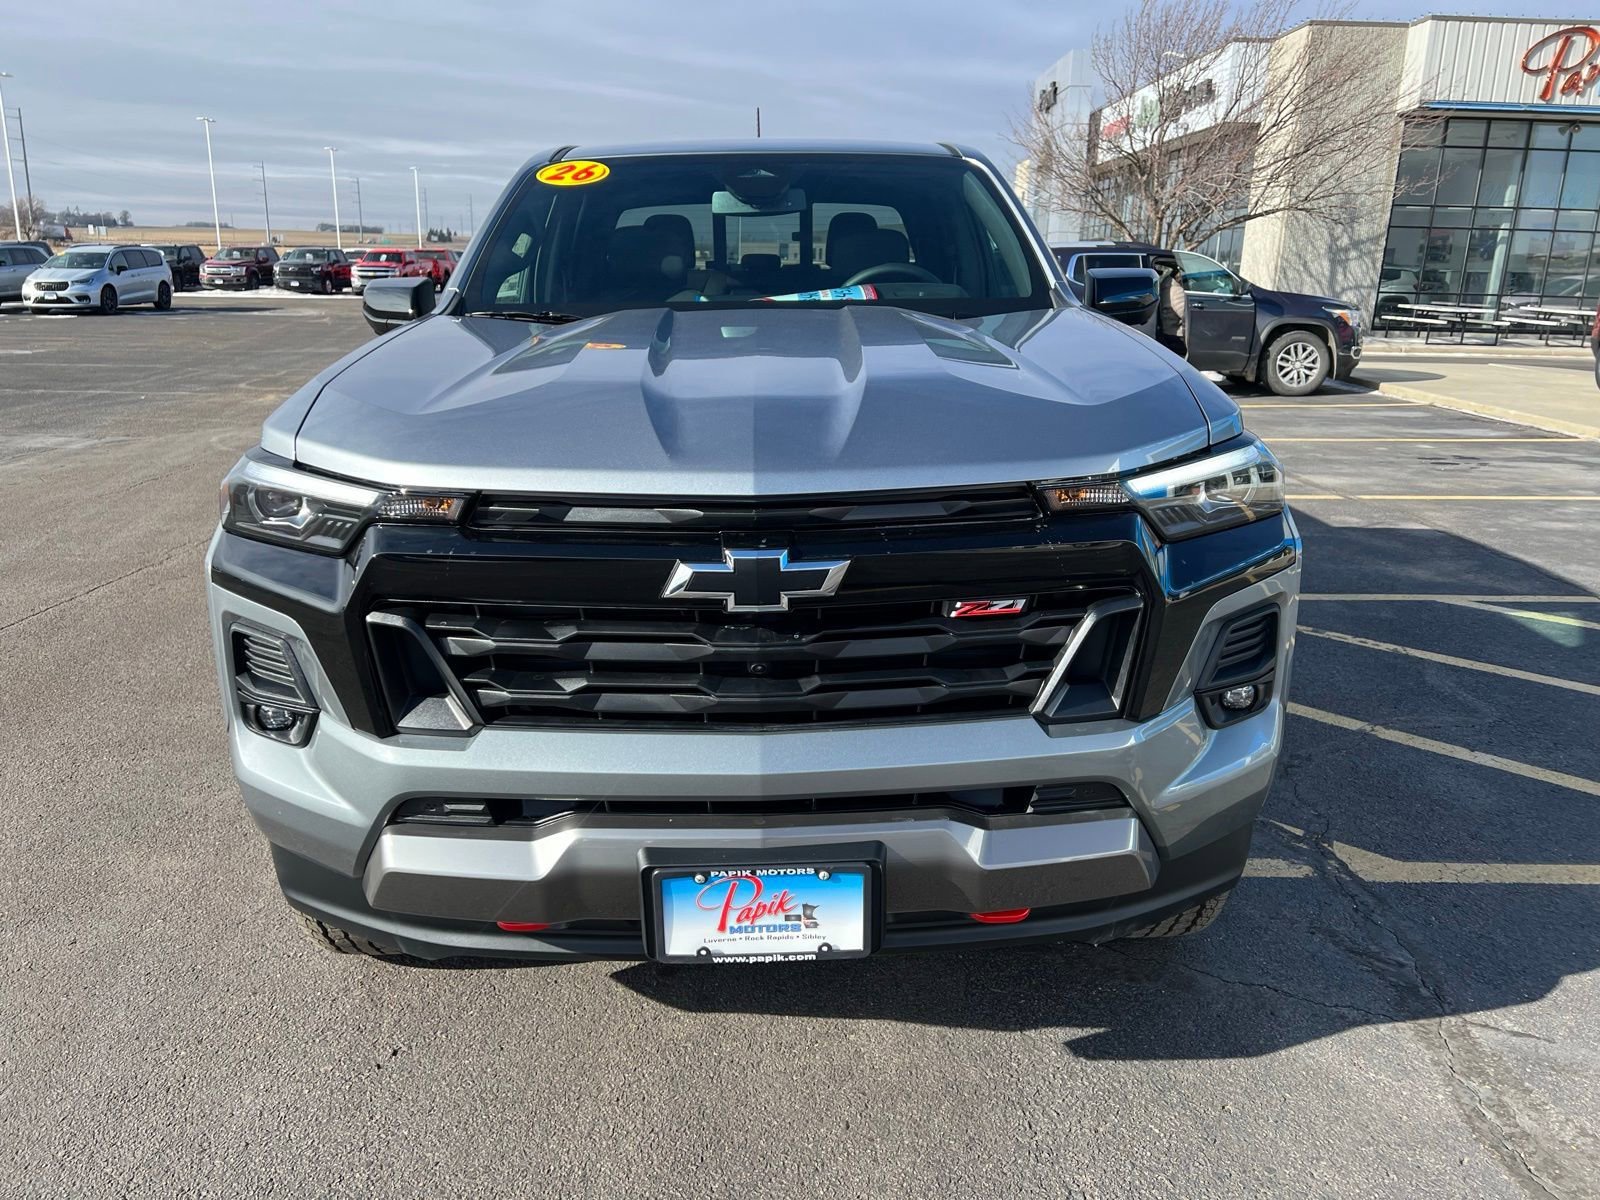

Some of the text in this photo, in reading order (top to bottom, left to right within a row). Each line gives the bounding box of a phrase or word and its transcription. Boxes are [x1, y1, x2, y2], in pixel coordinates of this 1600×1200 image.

[545, 164, 599, 181] 26
[950, 599, 1027, 618] Z71
[710, 867, 815, 878] PAPIK MOTORS
[696, 875, 798, 932] Papik
[729, 923, 801, 934] MOTORS
[712, 954, 816, 963] www.papik.com
